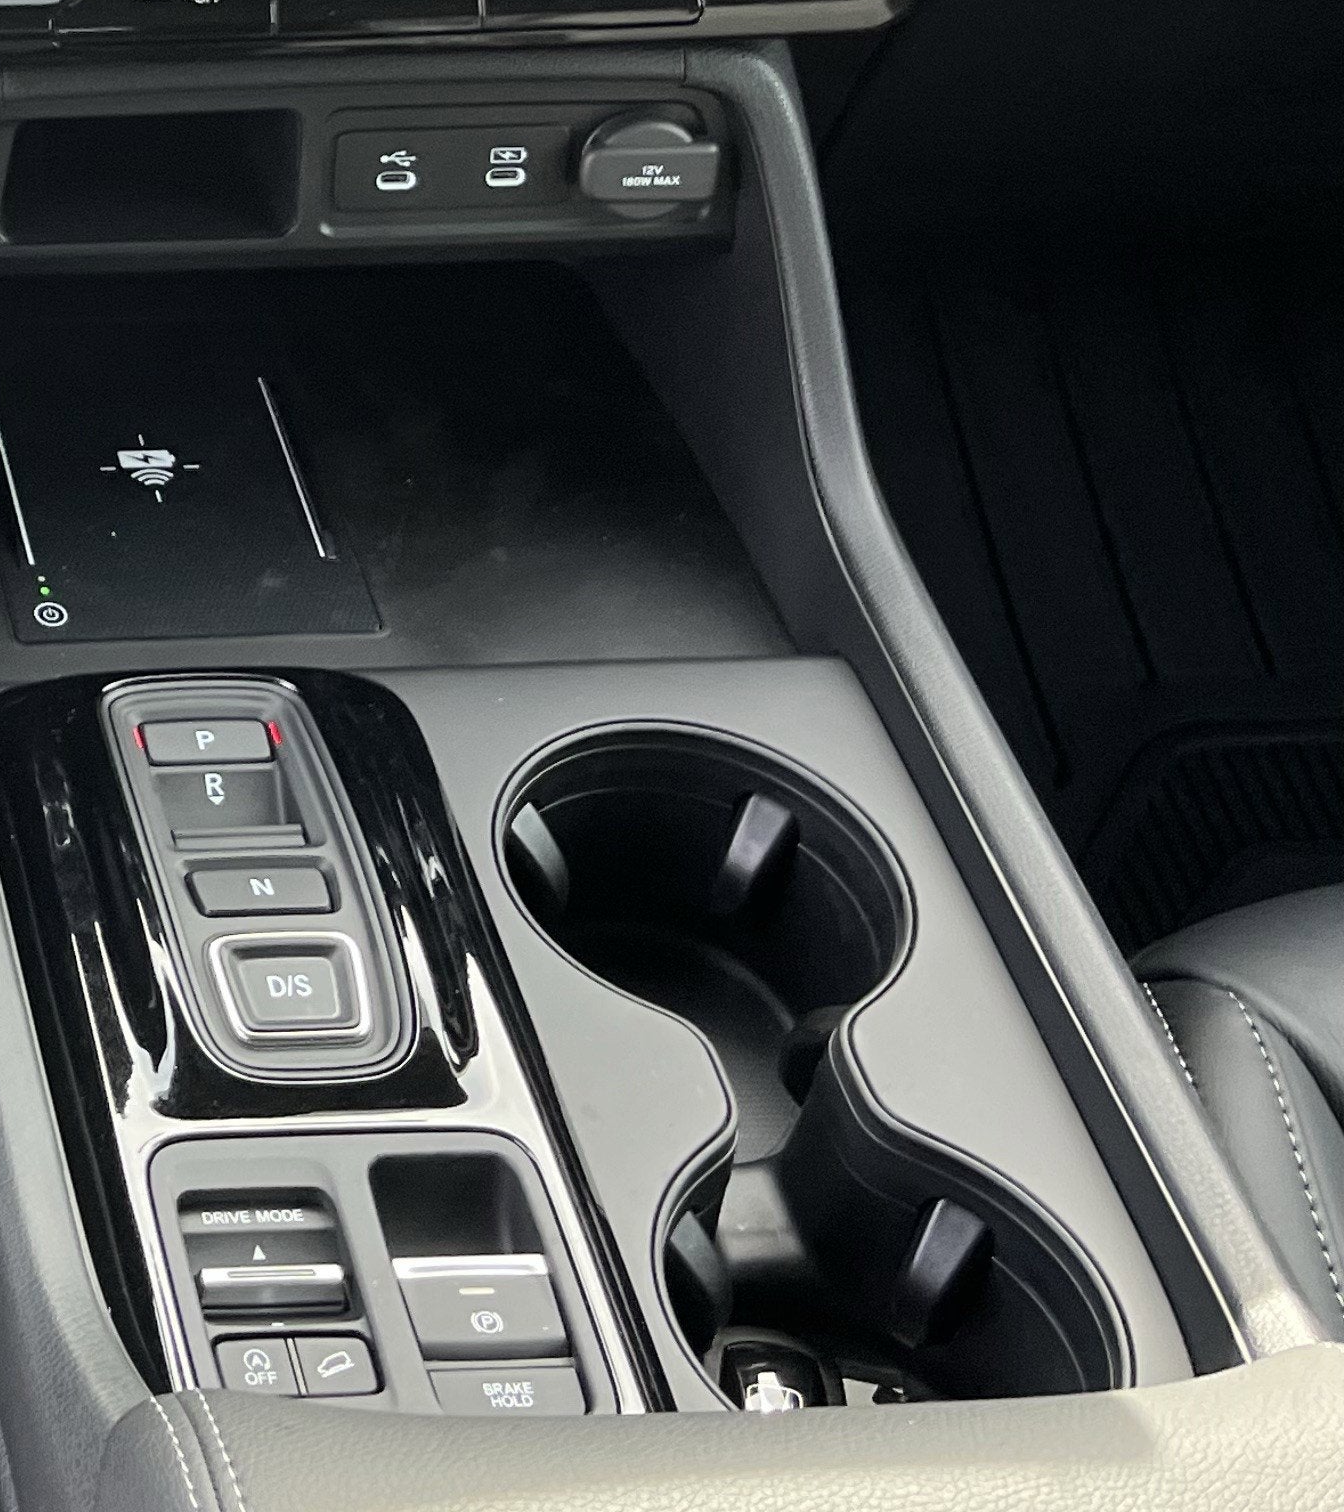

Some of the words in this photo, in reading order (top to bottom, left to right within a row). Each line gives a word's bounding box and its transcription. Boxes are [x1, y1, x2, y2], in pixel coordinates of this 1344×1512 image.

[642, 164, 663, 176] 12V
[653, 175, 680, 186] MAX
[195, 730, 214, 751] P
[205, 773, 223, 796] R
[250, 878, 274, 896] N
[265, 975, 313, 998] D/S
[201, 1210, 251, 1225] DRIVE
[255, 1208, 304, 1224] MODE
[244, 1371, 277, 1386] OFF
[482, 1381, 535, 1396] BRAKE
[489, 1394, 535, 1409] HOLD
